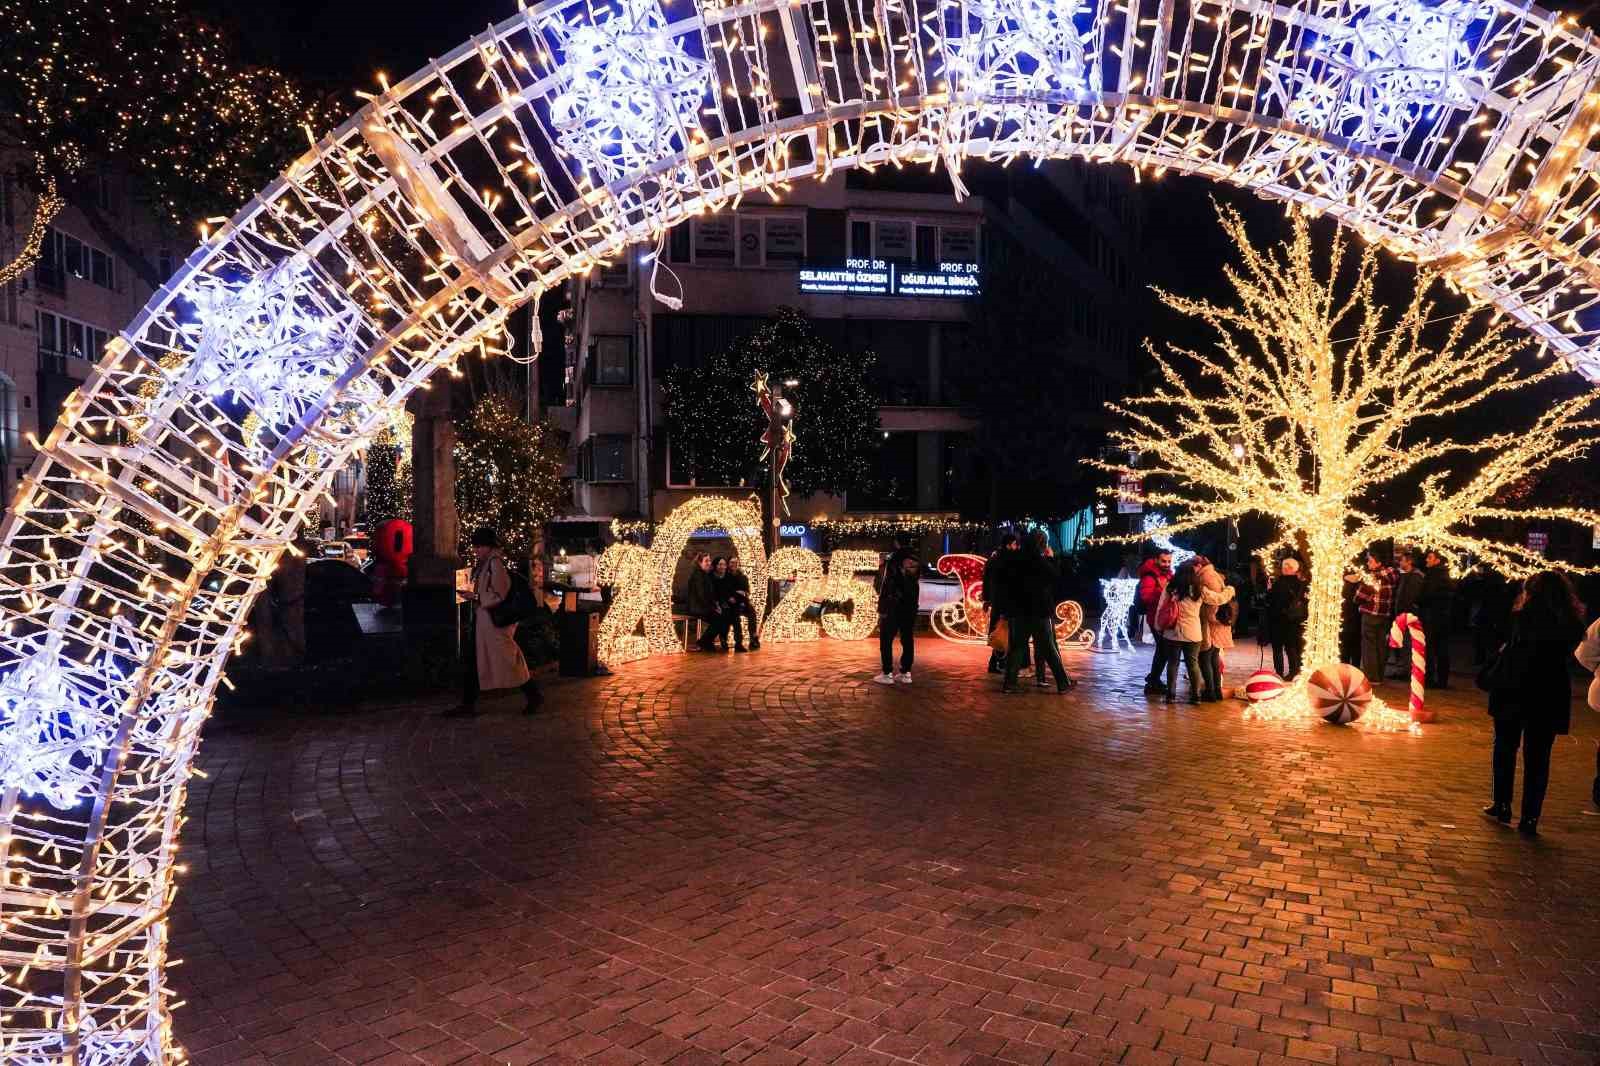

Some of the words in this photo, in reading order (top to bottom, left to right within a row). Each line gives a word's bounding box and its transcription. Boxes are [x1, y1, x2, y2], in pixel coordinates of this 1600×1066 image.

[846, 259, 870, 269] PROF.
[872, 260, 887, 270] DR.
[940, 263, 964, 273] PROF.
[966, 264, 980, 273] DR.
[901, 273, 926, 285] UĞUR
